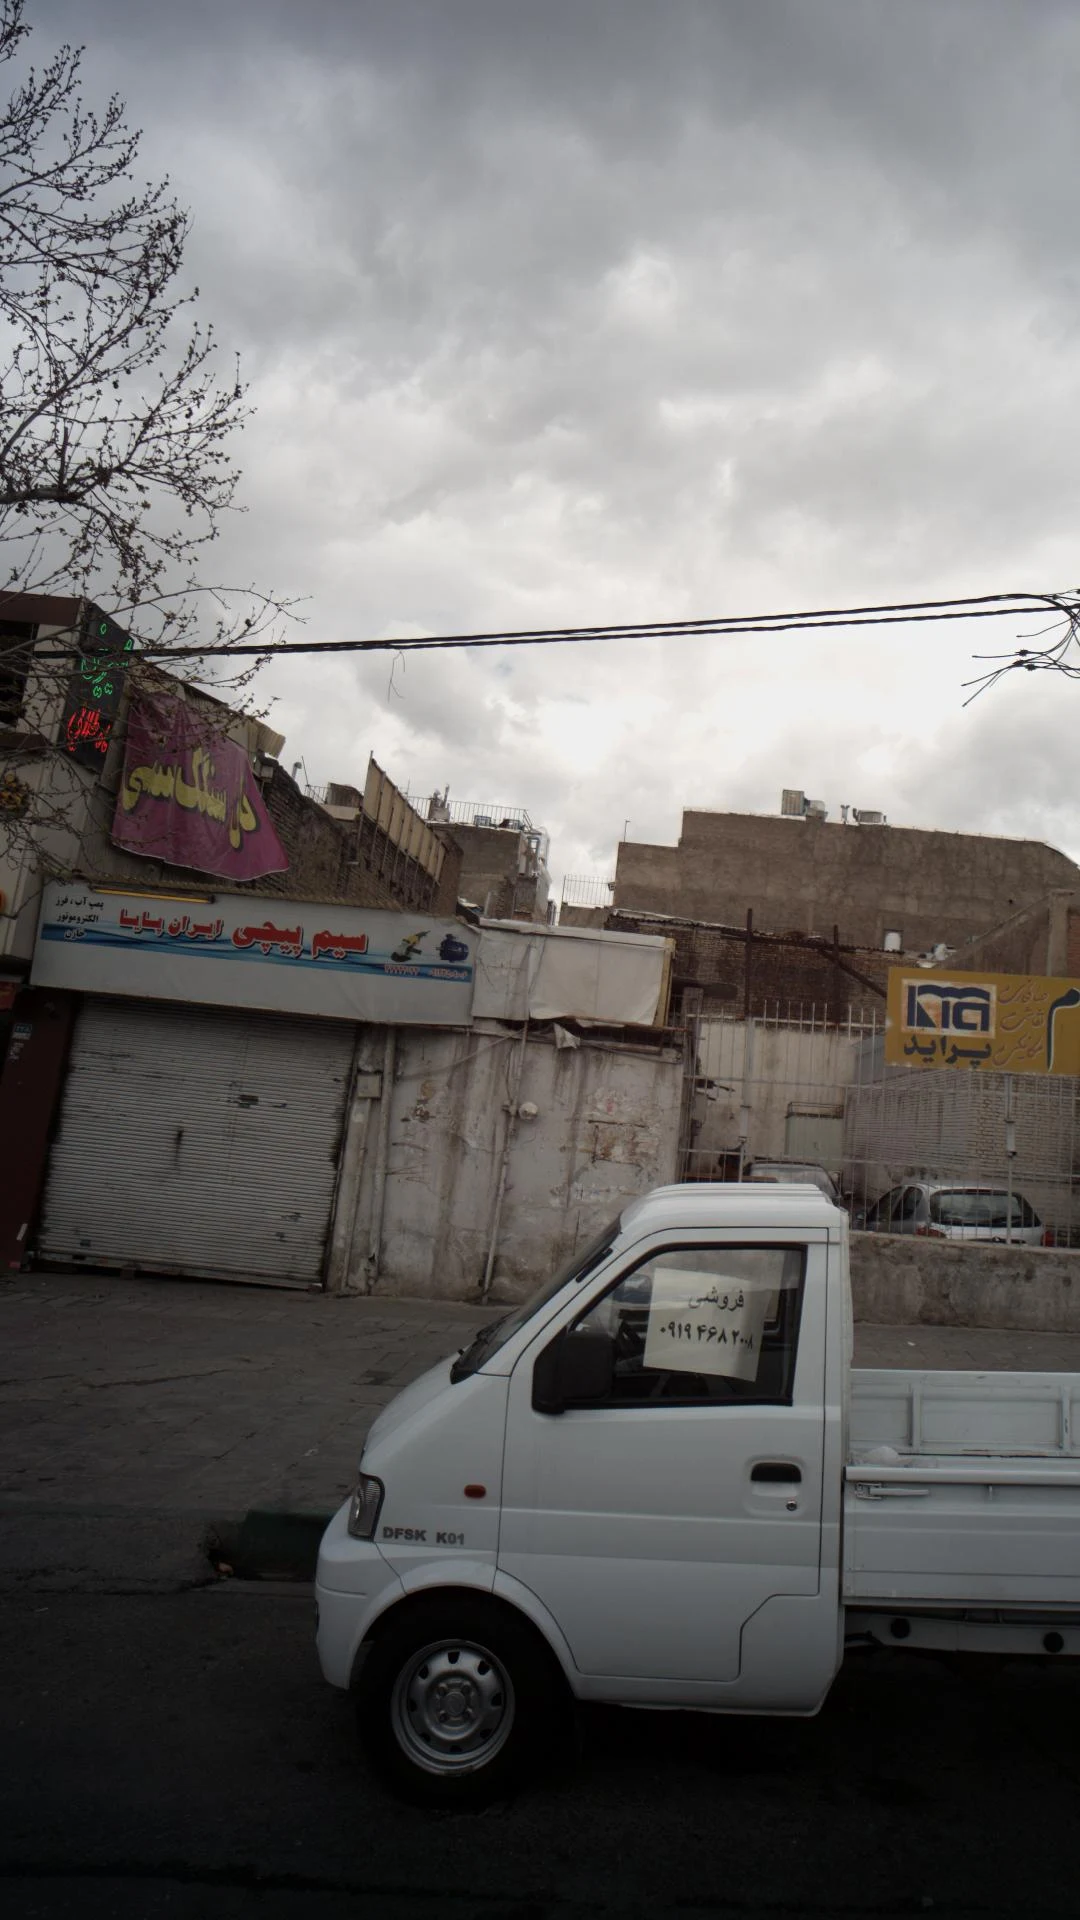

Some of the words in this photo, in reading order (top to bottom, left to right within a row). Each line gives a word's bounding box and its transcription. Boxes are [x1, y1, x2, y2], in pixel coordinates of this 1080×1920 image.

[167, 914, 224, 939] ایران
[232, 919, 304, 957] پیچی
[312, 929, 369, 959] سیم
[996, 978, 1049, 1004] صافکاری
[1000, 1006, 1045, 1032] نقاشی
[903, 1034, 993, 1069] پراید
[992, 1032, 1043, 1066] مکانیکی
[688, 1286, 745, 1311] فروشی
[659, 1320, 692, 1340] ۰۹۱۹
[383, 1526, 427, 1541] DFSK
[436, 1531, 465, 1545] K01
